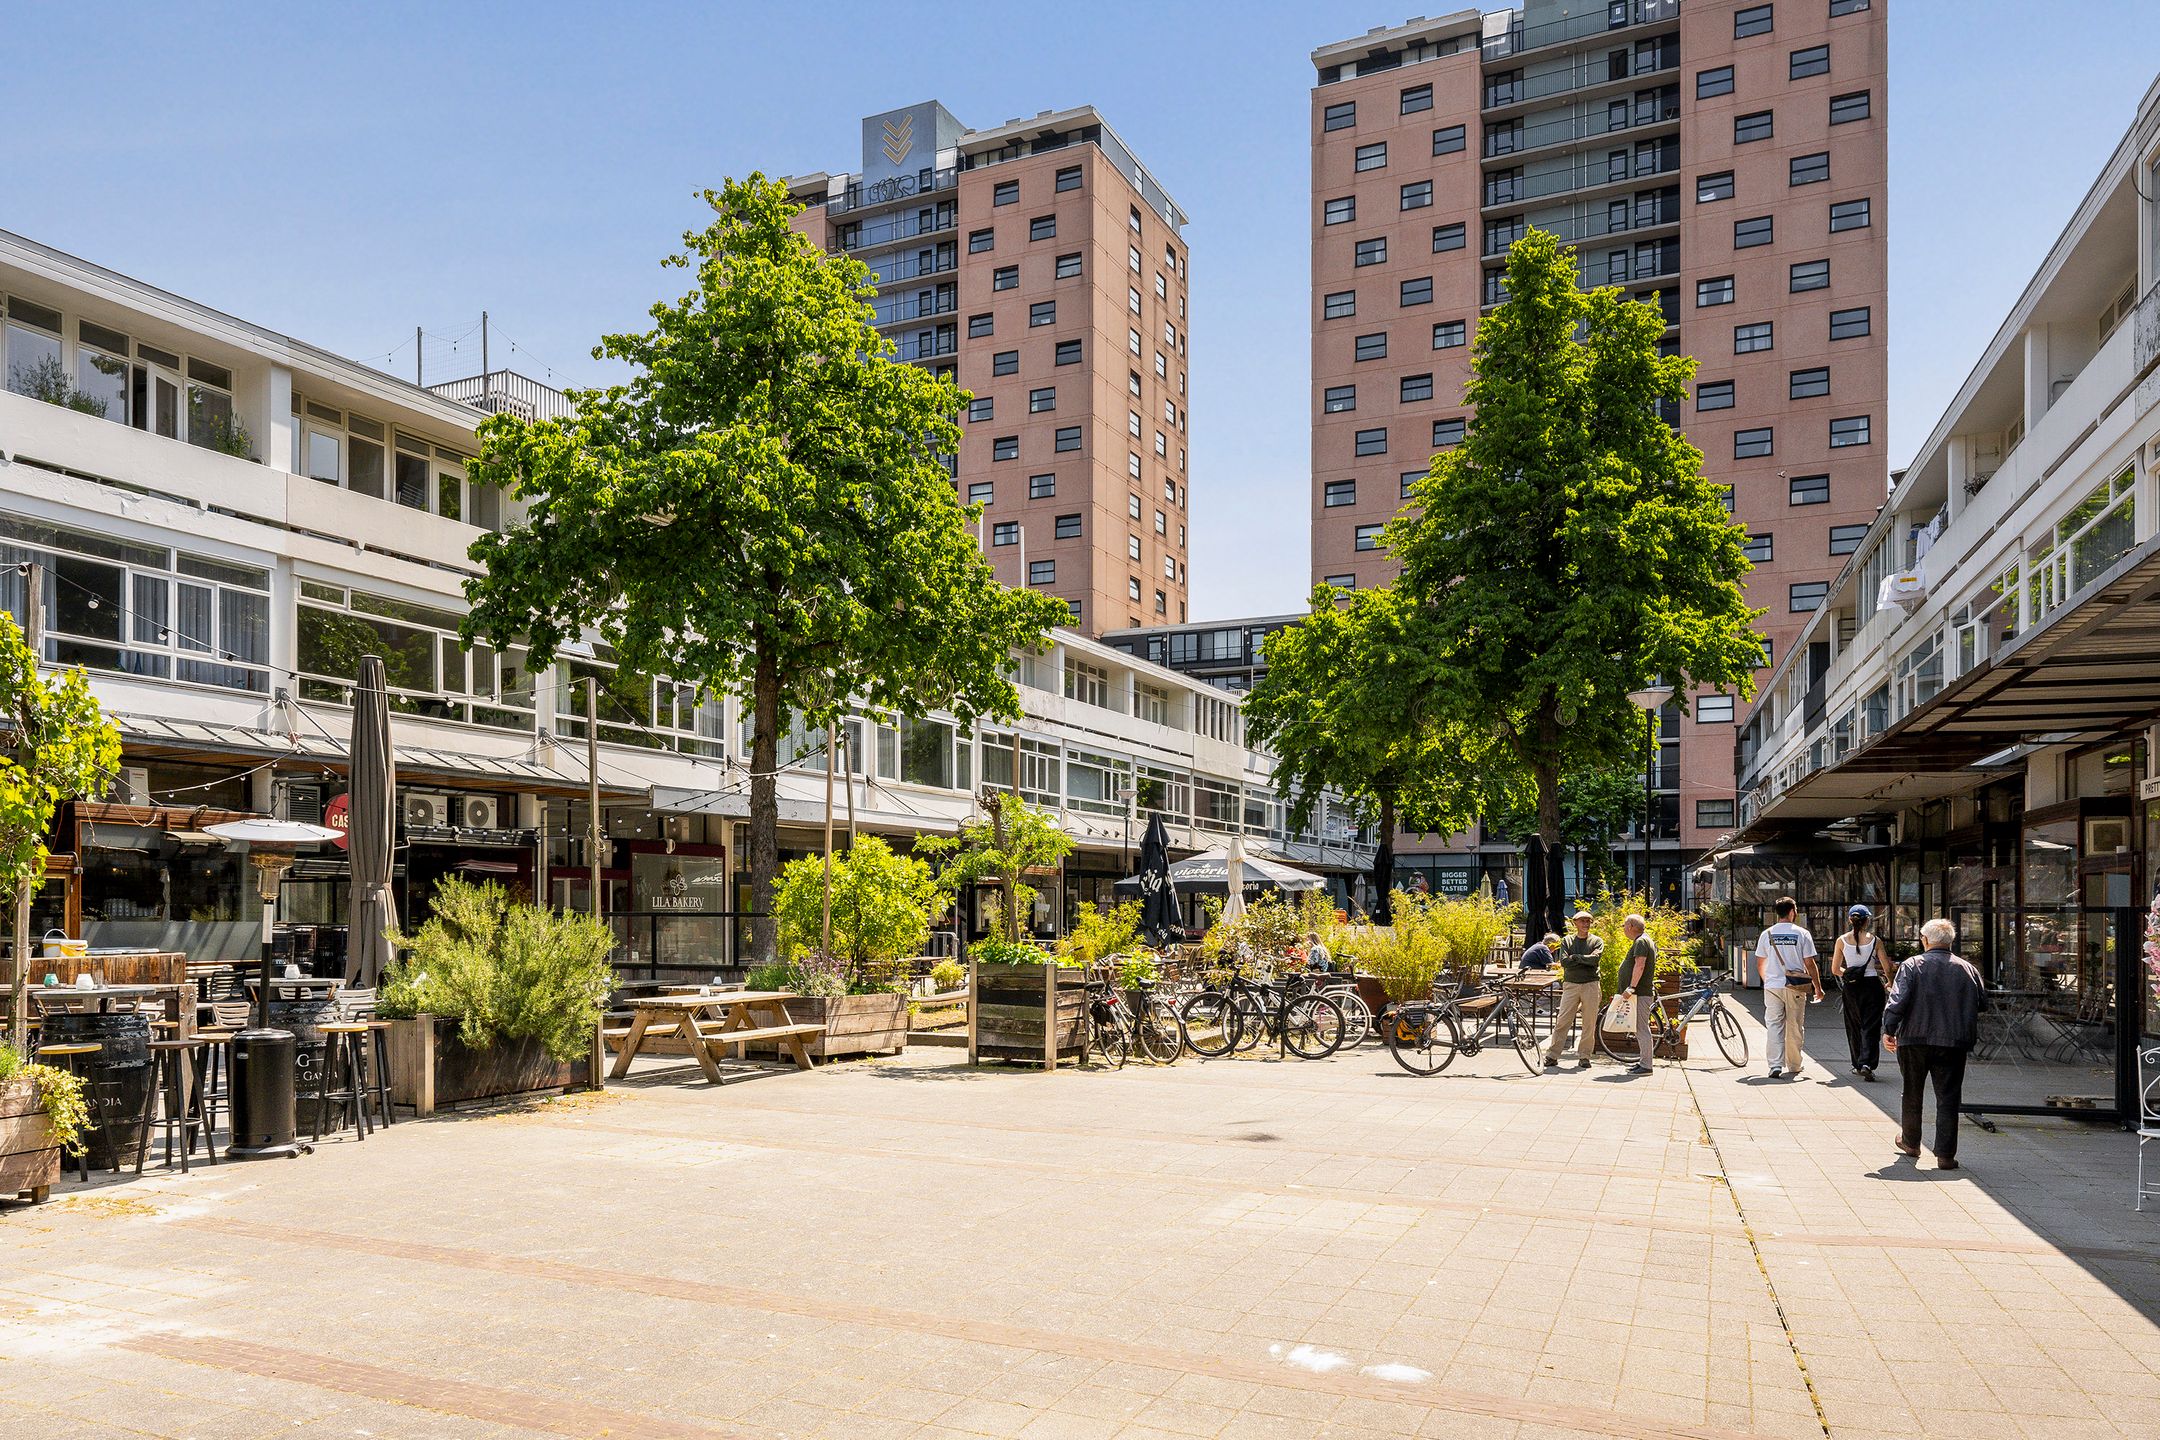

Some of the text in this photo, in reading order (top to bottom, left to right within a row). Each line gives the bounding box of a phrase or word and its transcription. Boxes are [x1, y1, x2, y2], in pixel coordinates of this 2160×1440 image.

[1242, 881, 1259, 890] toria
[652, 896, 705, 911] LILA BAKERY
